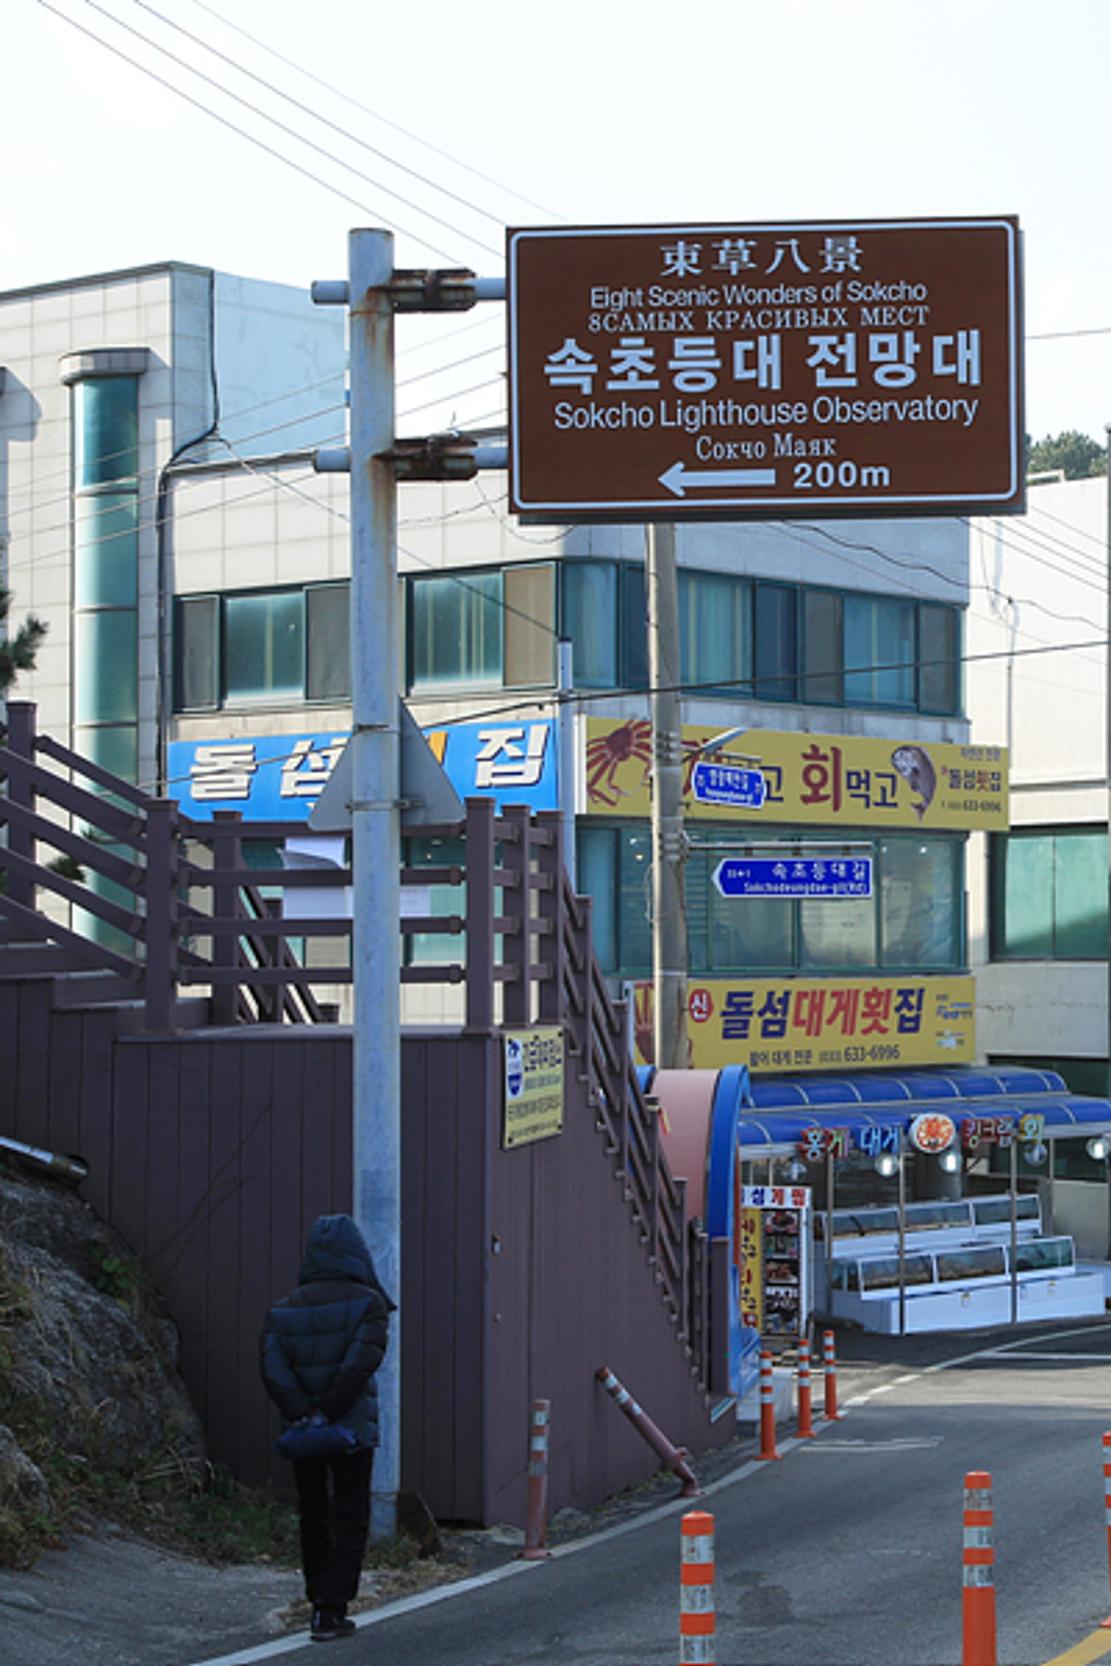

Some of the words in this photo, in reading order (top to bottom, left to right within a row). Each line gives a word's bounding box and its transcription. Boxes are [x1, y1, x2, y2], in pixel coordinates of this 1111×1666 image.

[590, 287, 642, 310] Eight
[647, 285, 719, 307] Scenic
[723, 283, 818, 306] Wonders
[821, 282, 842, 304] of
[846, 280, 928, 302] Sokcho
[706, 307, 848, 331] КРАСИВЫХ
[860, 305, 930, 326] МЕСТ
[543, 333, 782, 396] 속초등대
[805, 329, 982, 389] 전망대
[553, 401, 655, 430] Sokcho
[660, 398, 808, 430] Lighthouse
[812, 394, 979, 427] Observatory
[695, 435, 767, 461] Сокчо
[773, 432, 837, 458] Маяк
[793, 461, 891, 489] 200m
[720, 987, 925, 1040] 돌섬대게횟집
